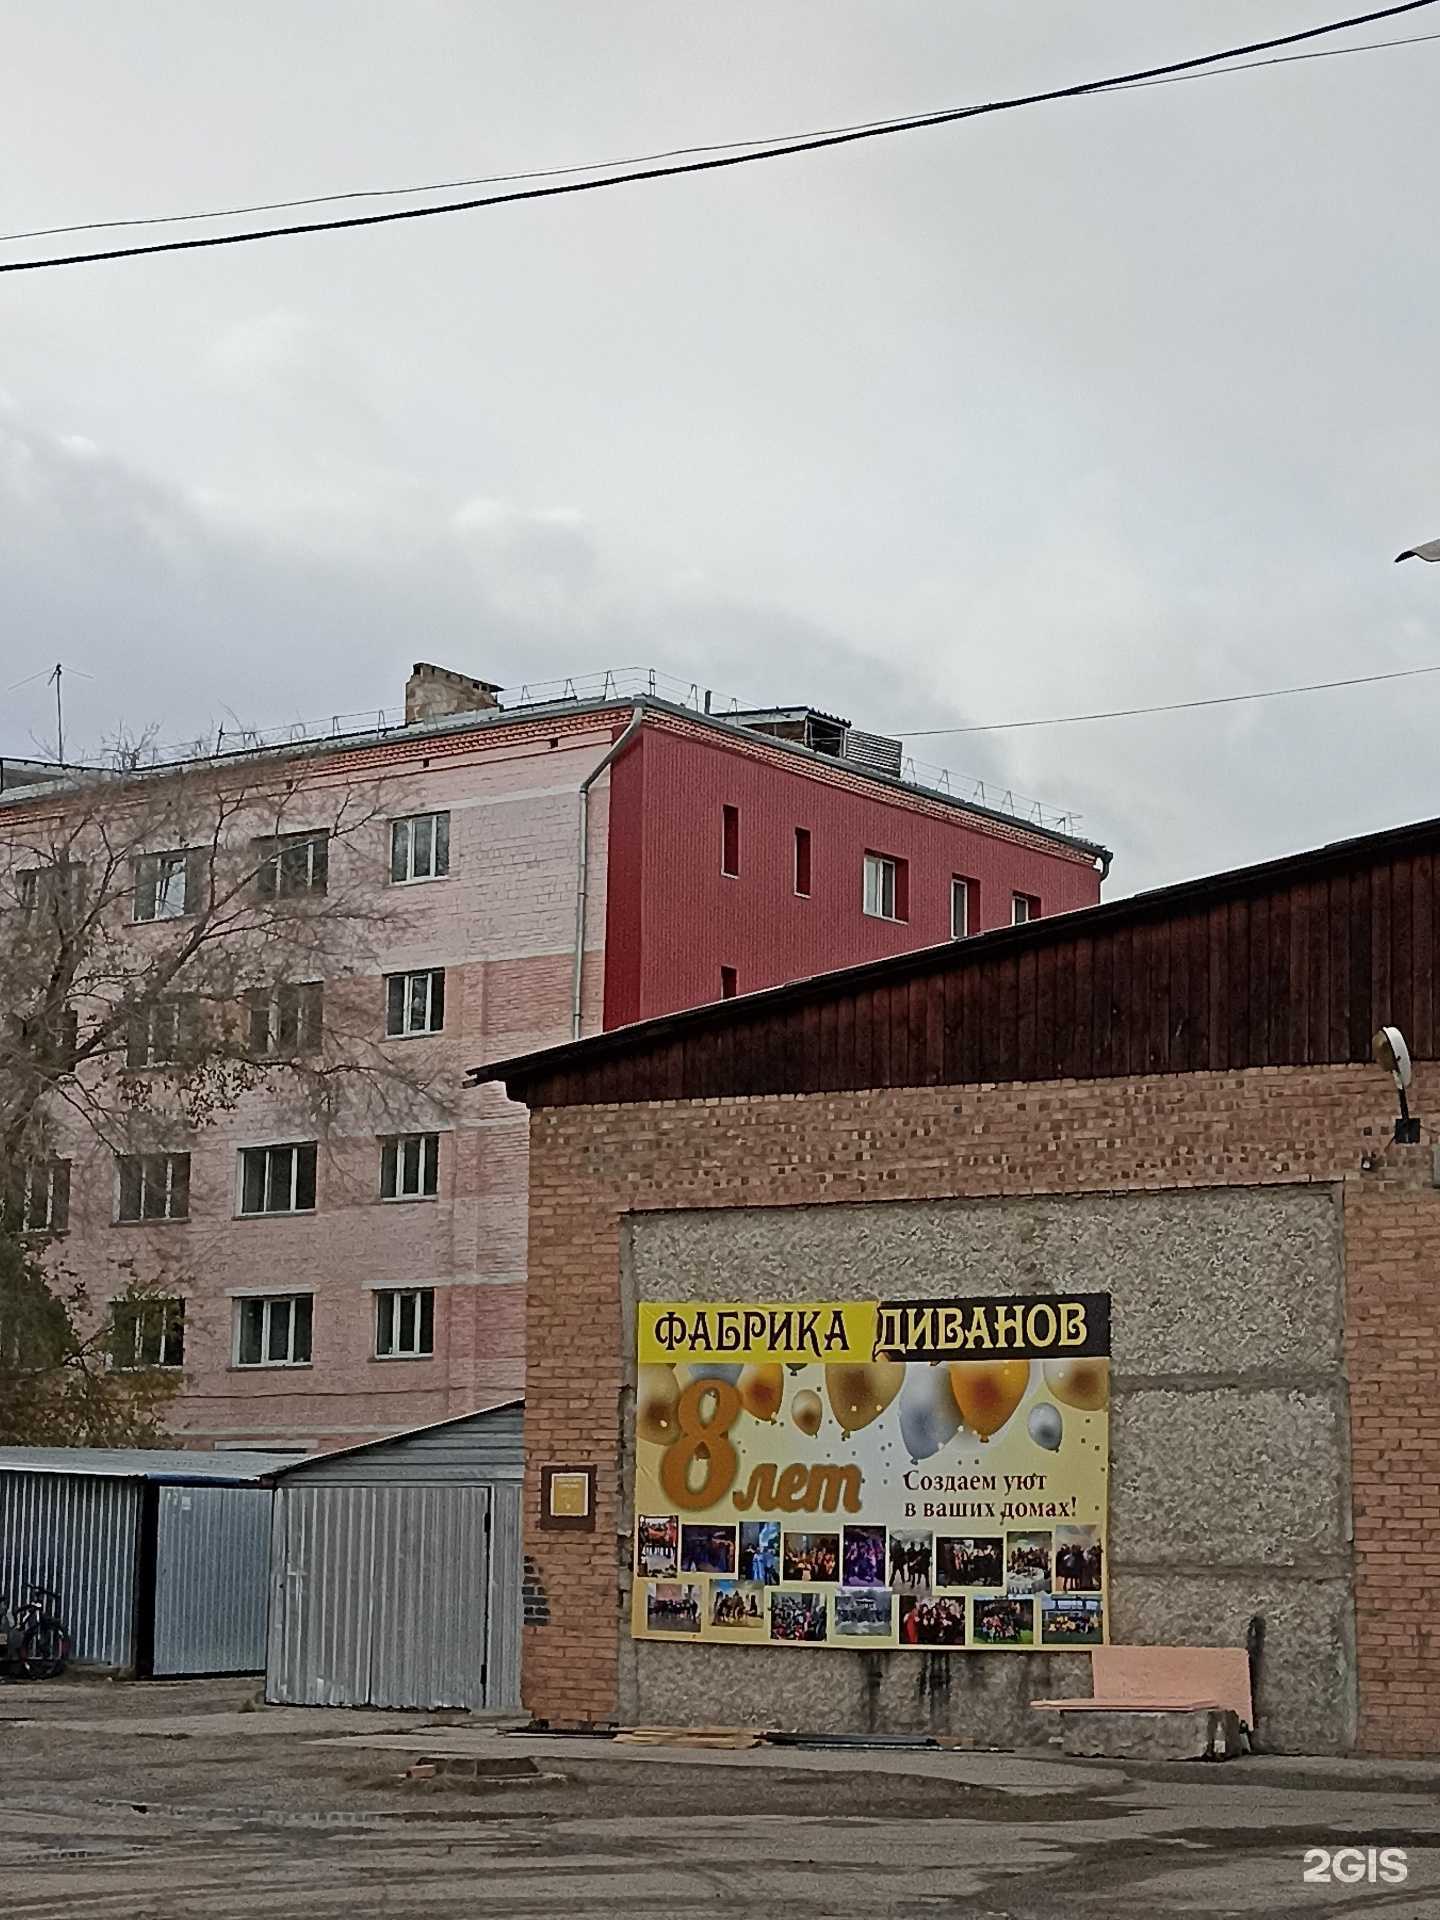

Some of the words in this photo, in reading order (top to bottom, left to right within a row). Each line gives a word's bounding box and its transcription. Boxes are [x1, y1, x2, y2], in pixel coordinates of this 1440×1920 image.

[654, 1310, 850, 1358] ФАБРИКА
[874, 1302, 1087, 1354] ДИВАНОВ
[660, 1377, 744, 1513] 8
[733, 1462, 863, 1514] лет
[903, 1470, 996, 1493] Создаем
[1003, 1473, 1047, 1496] уют
[905, 1502, 917, 1518] в
[924, 1502, 995, 1518] ваших
[1001, 1496, 1077, 1521] домах!
